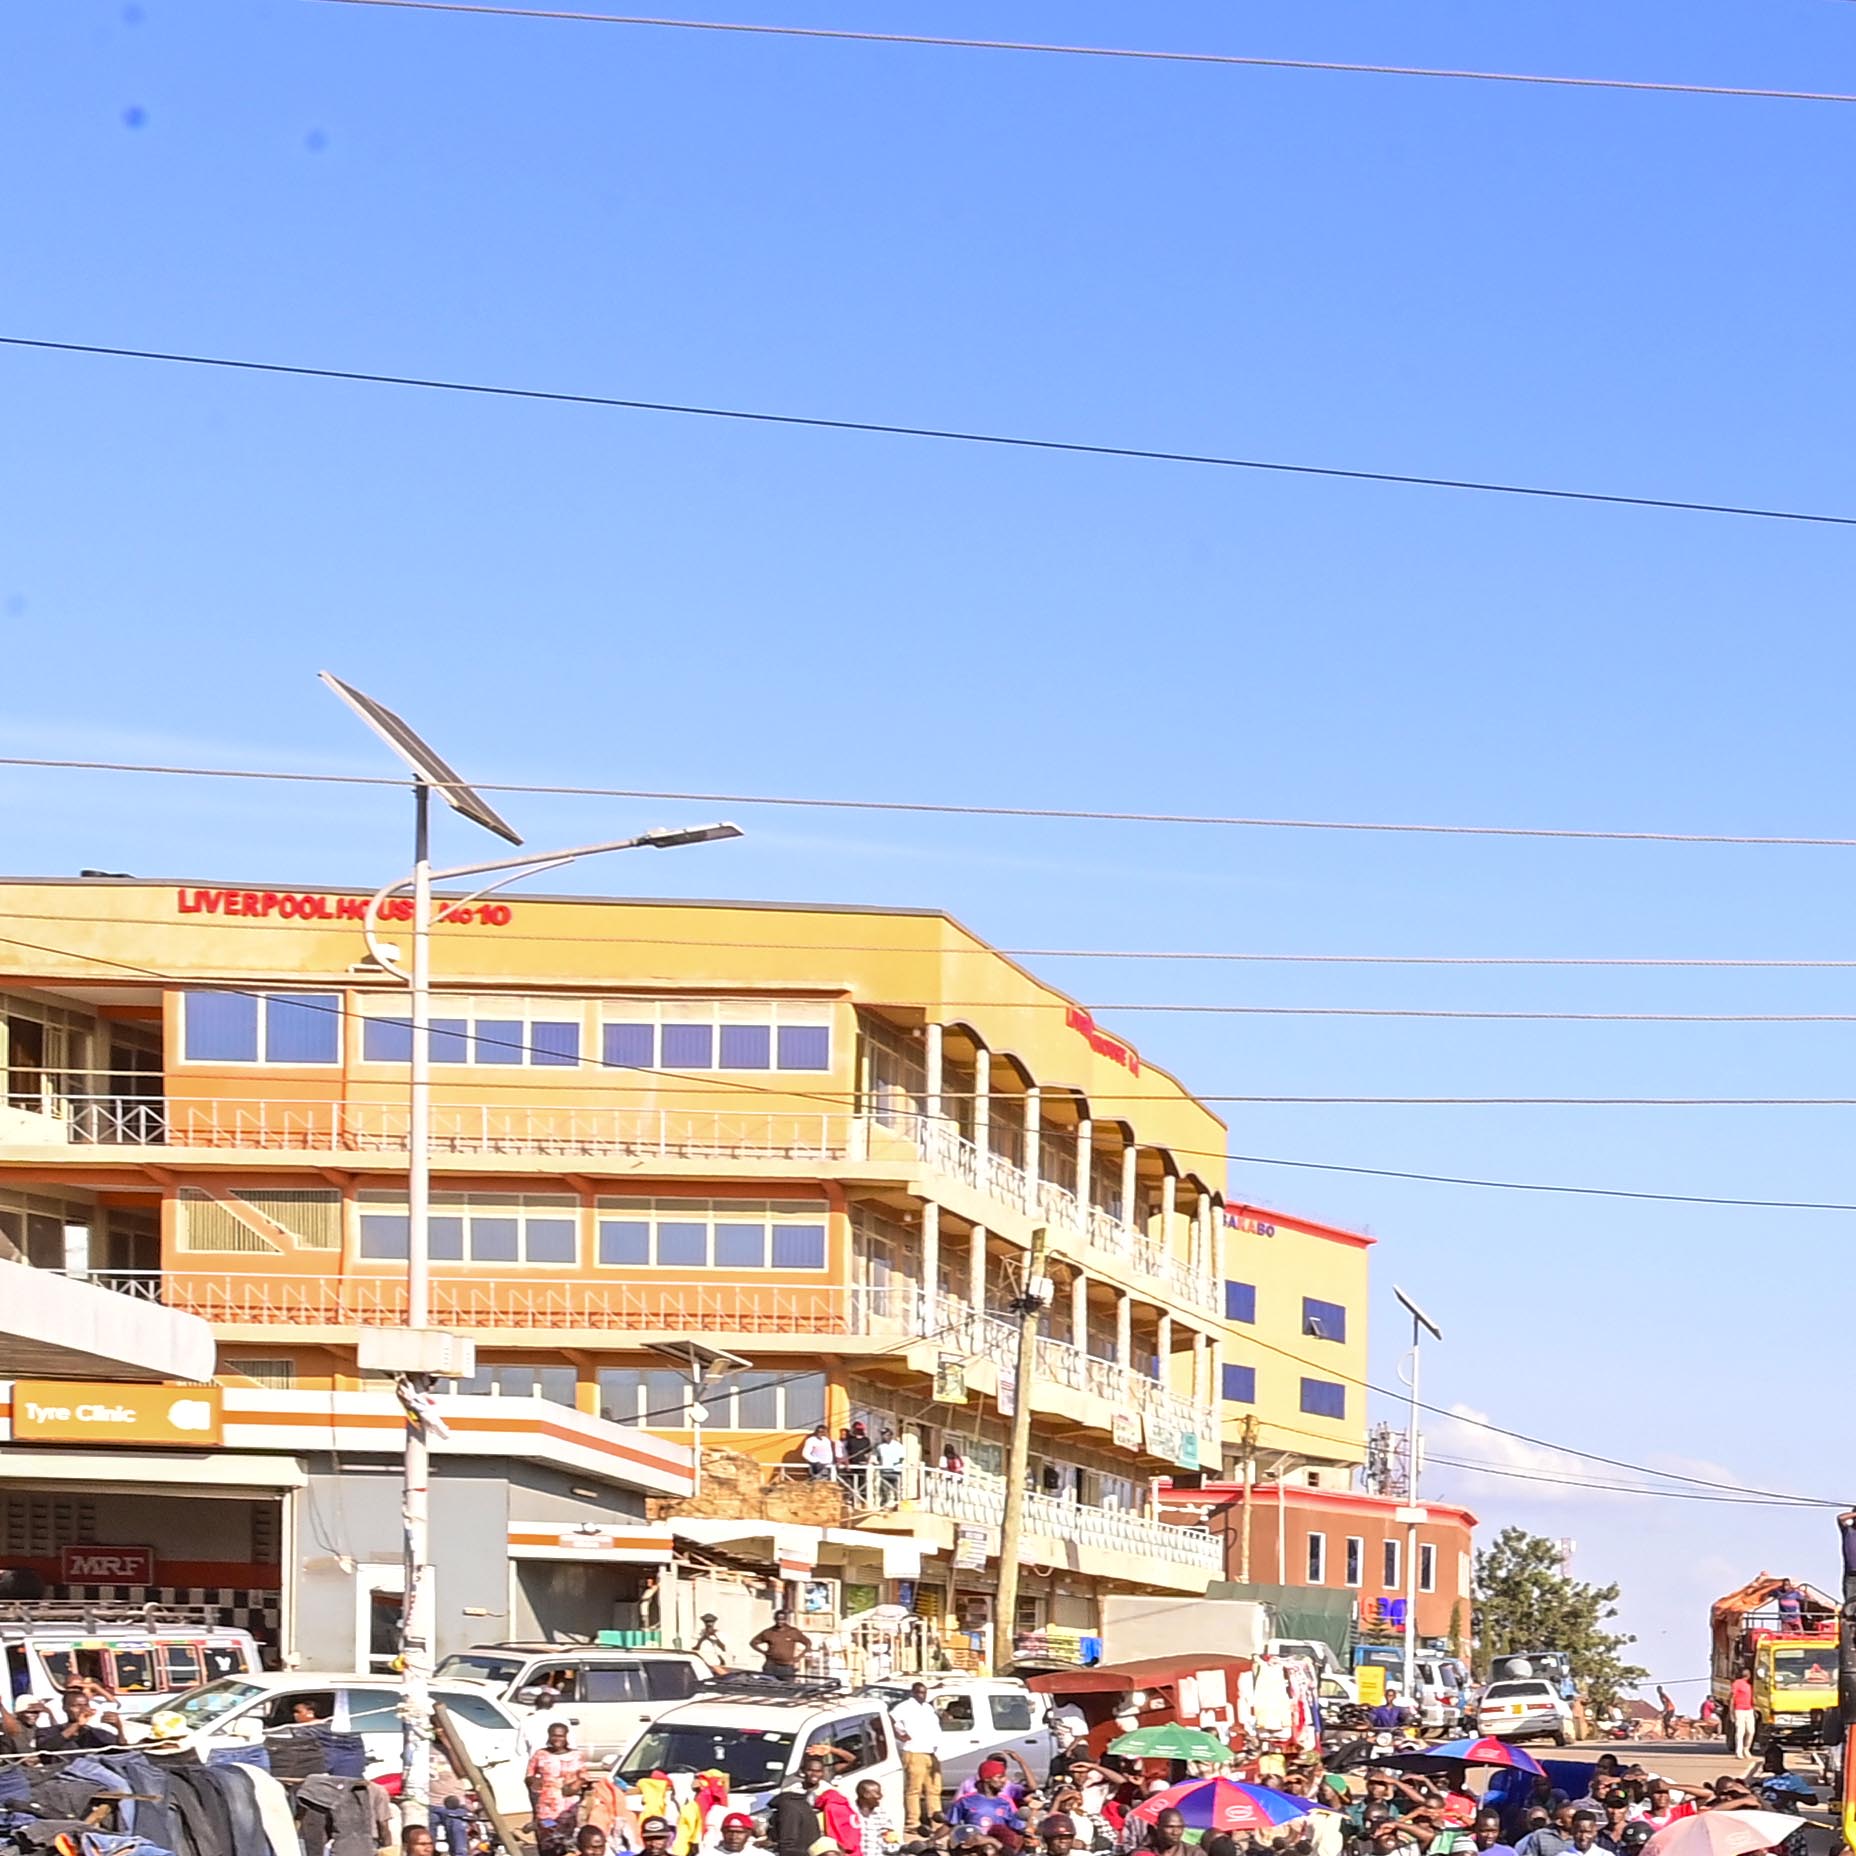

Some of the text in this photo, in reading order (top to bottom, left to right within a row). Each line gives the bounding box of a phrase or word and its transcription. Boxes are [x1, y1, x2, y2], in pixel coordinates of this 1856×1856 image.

[177, 888, 334, 919] LIVERPOOL
[339, 896, 415, 922] HOUS
[25, 1402, 136, 1424] Tyre Clinic
[69, 1555, 145, 1576] MRF
